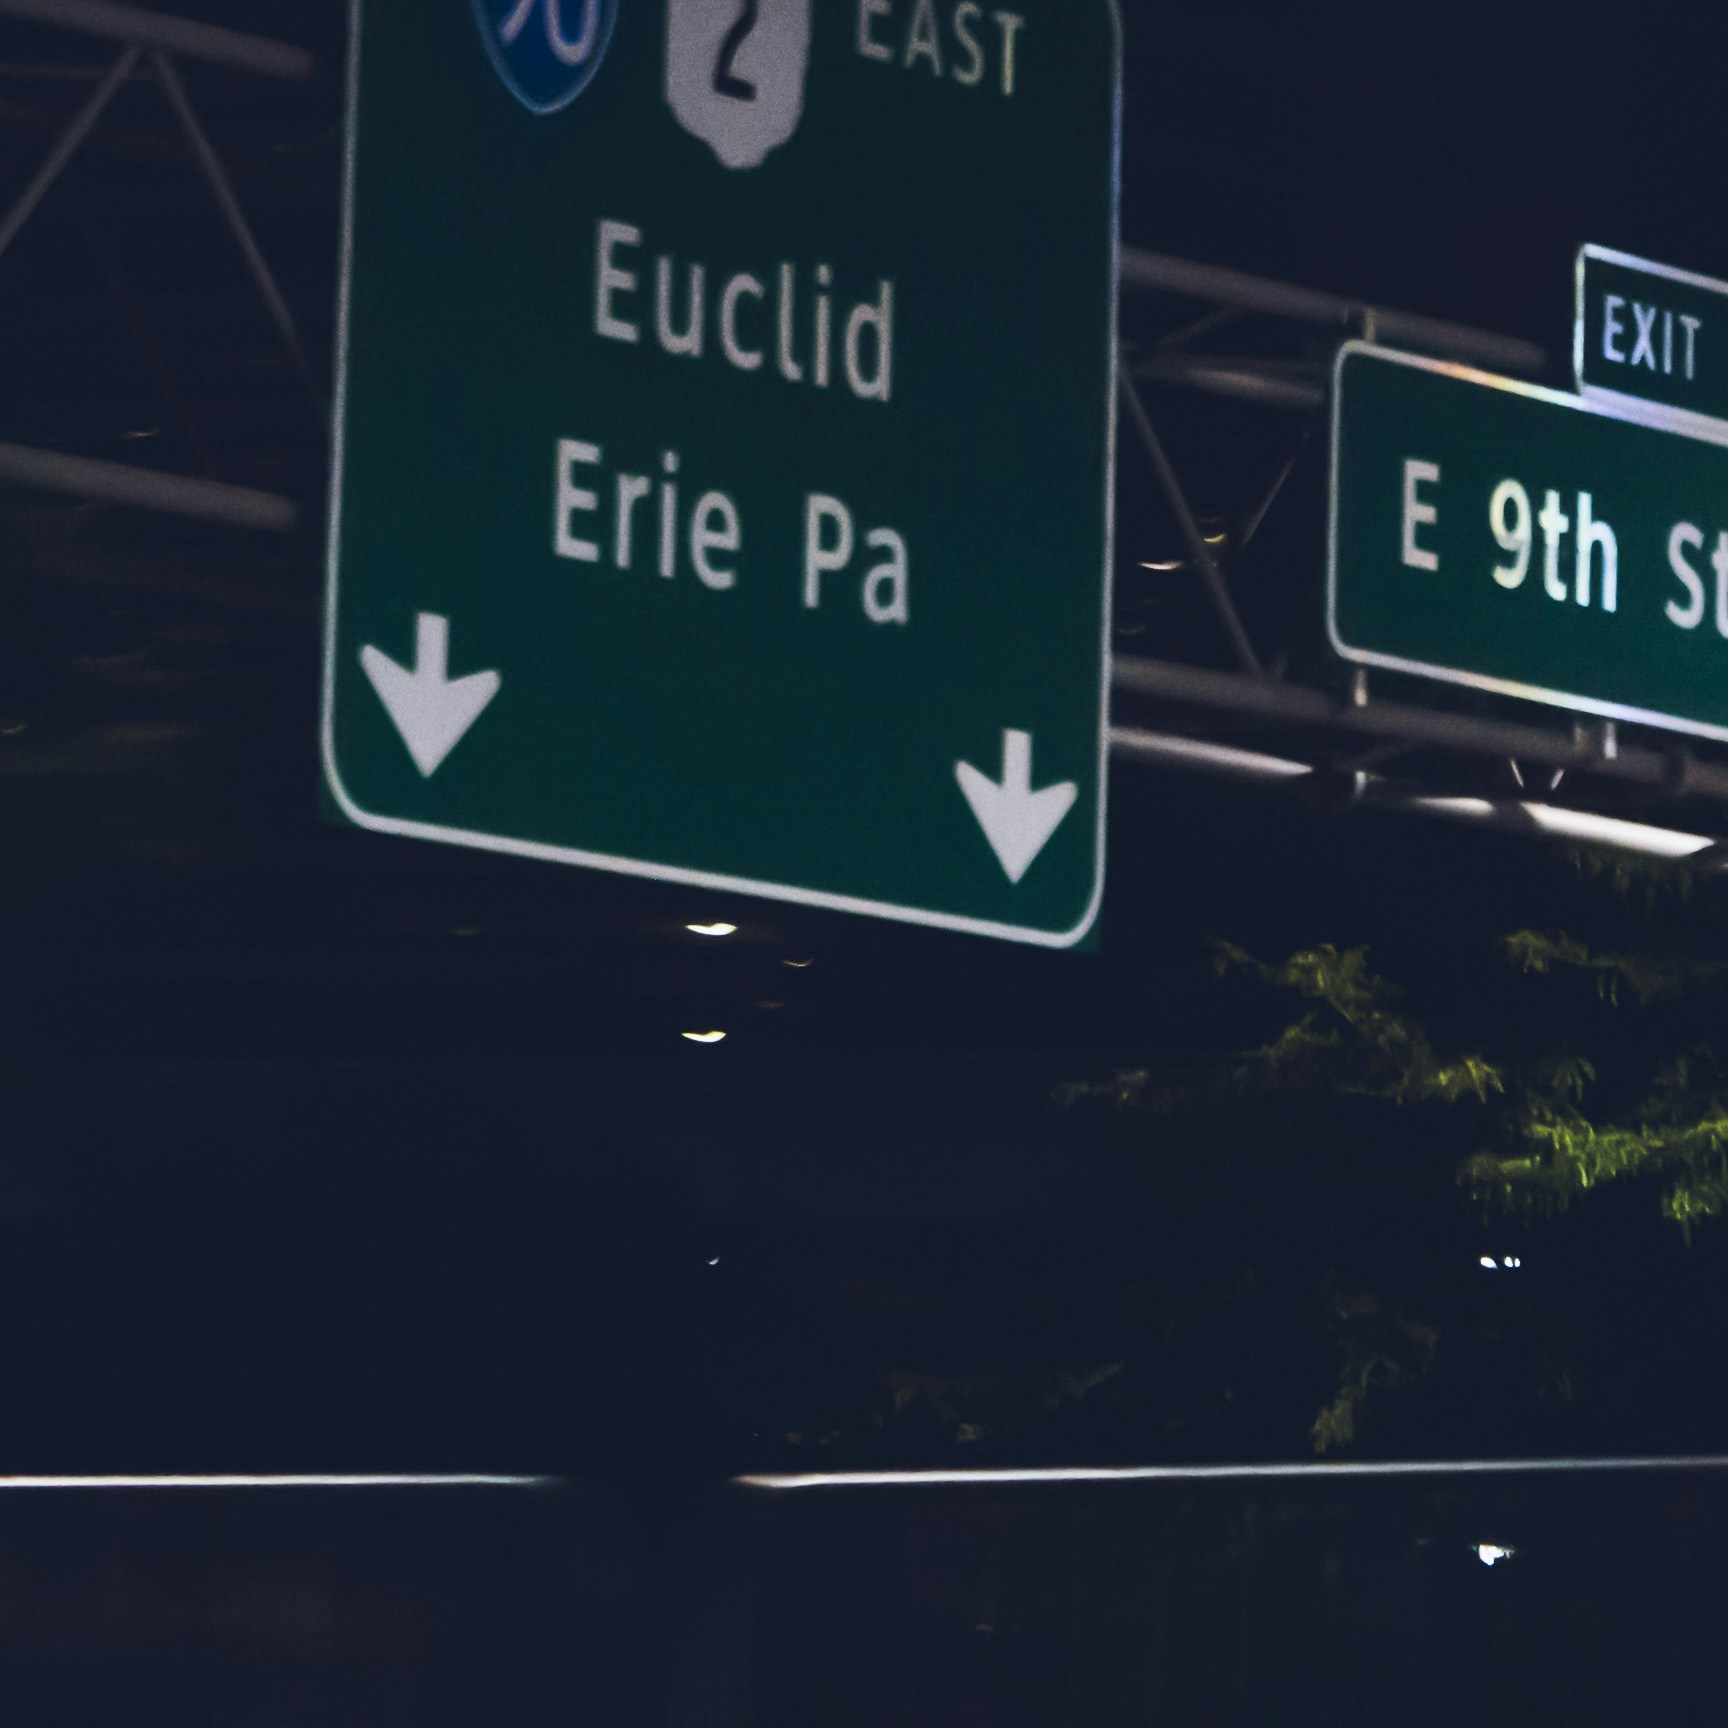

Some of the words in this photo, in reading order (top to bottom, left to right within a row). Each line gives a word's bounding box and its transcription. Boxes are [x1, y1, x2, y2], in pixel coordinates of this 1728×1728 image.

[594, 218, 895, 402] Euclid
[1601, 294, 1702, 381] EXIT
[552, 436, 743, 590] Erie
[802, 493, 910, 626] Pa
[1401, 458, 1441, 572] E
[1488, 478, 1619, 614] 9th
